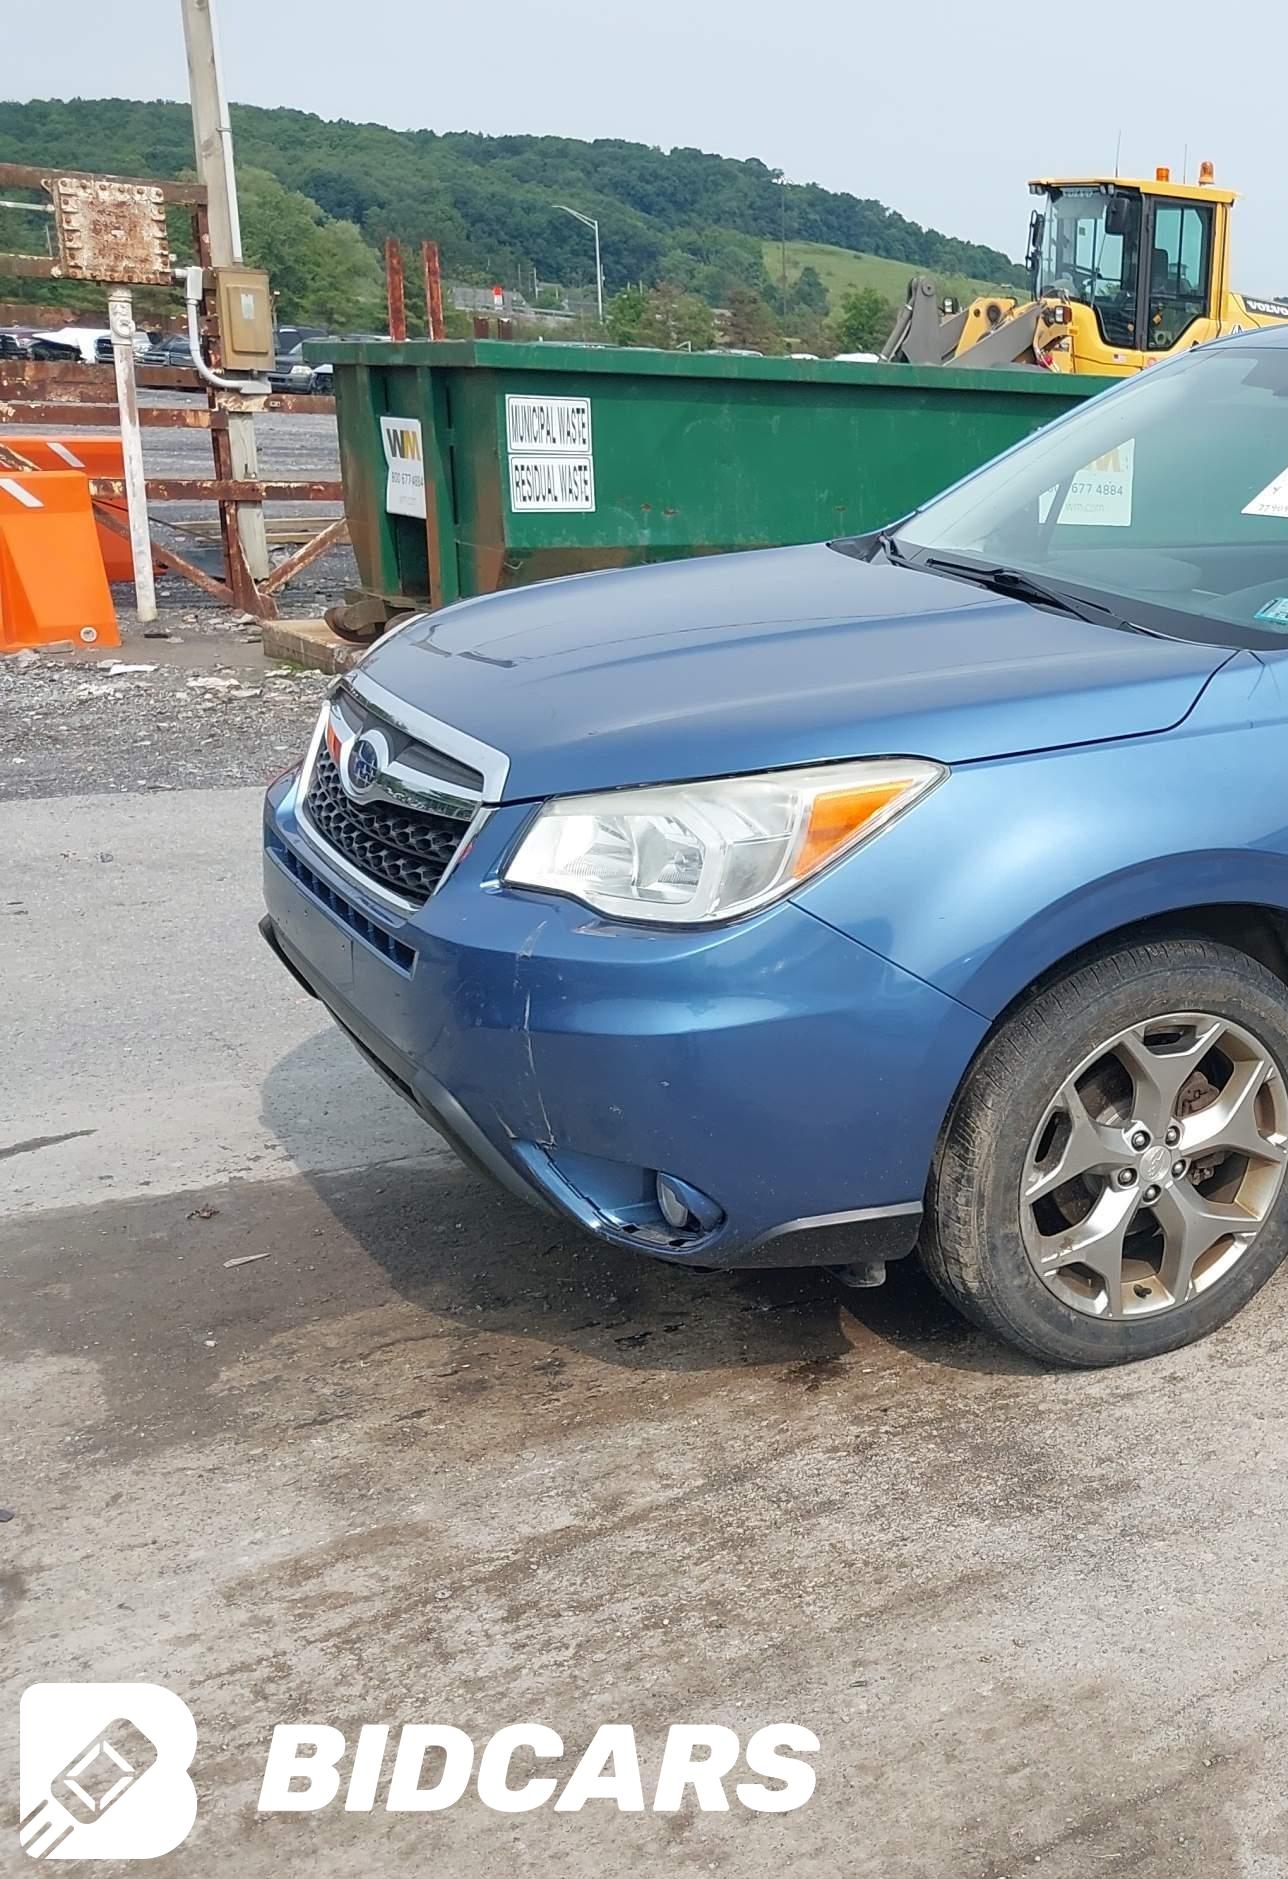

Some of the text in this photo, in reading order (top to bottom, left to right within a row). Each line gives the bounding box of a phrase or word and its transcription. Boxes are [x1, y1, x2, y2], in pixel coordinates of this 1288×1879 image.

[511, 404, 587, 445] MUNICIPAL WASTE
[386, 428, 422, 462] WM
[514, 464, 590, 502] RESIDUAL WASTE
[1071, 483, 1093, 494] 677
[1095, 484, 1123, 496] 4884
